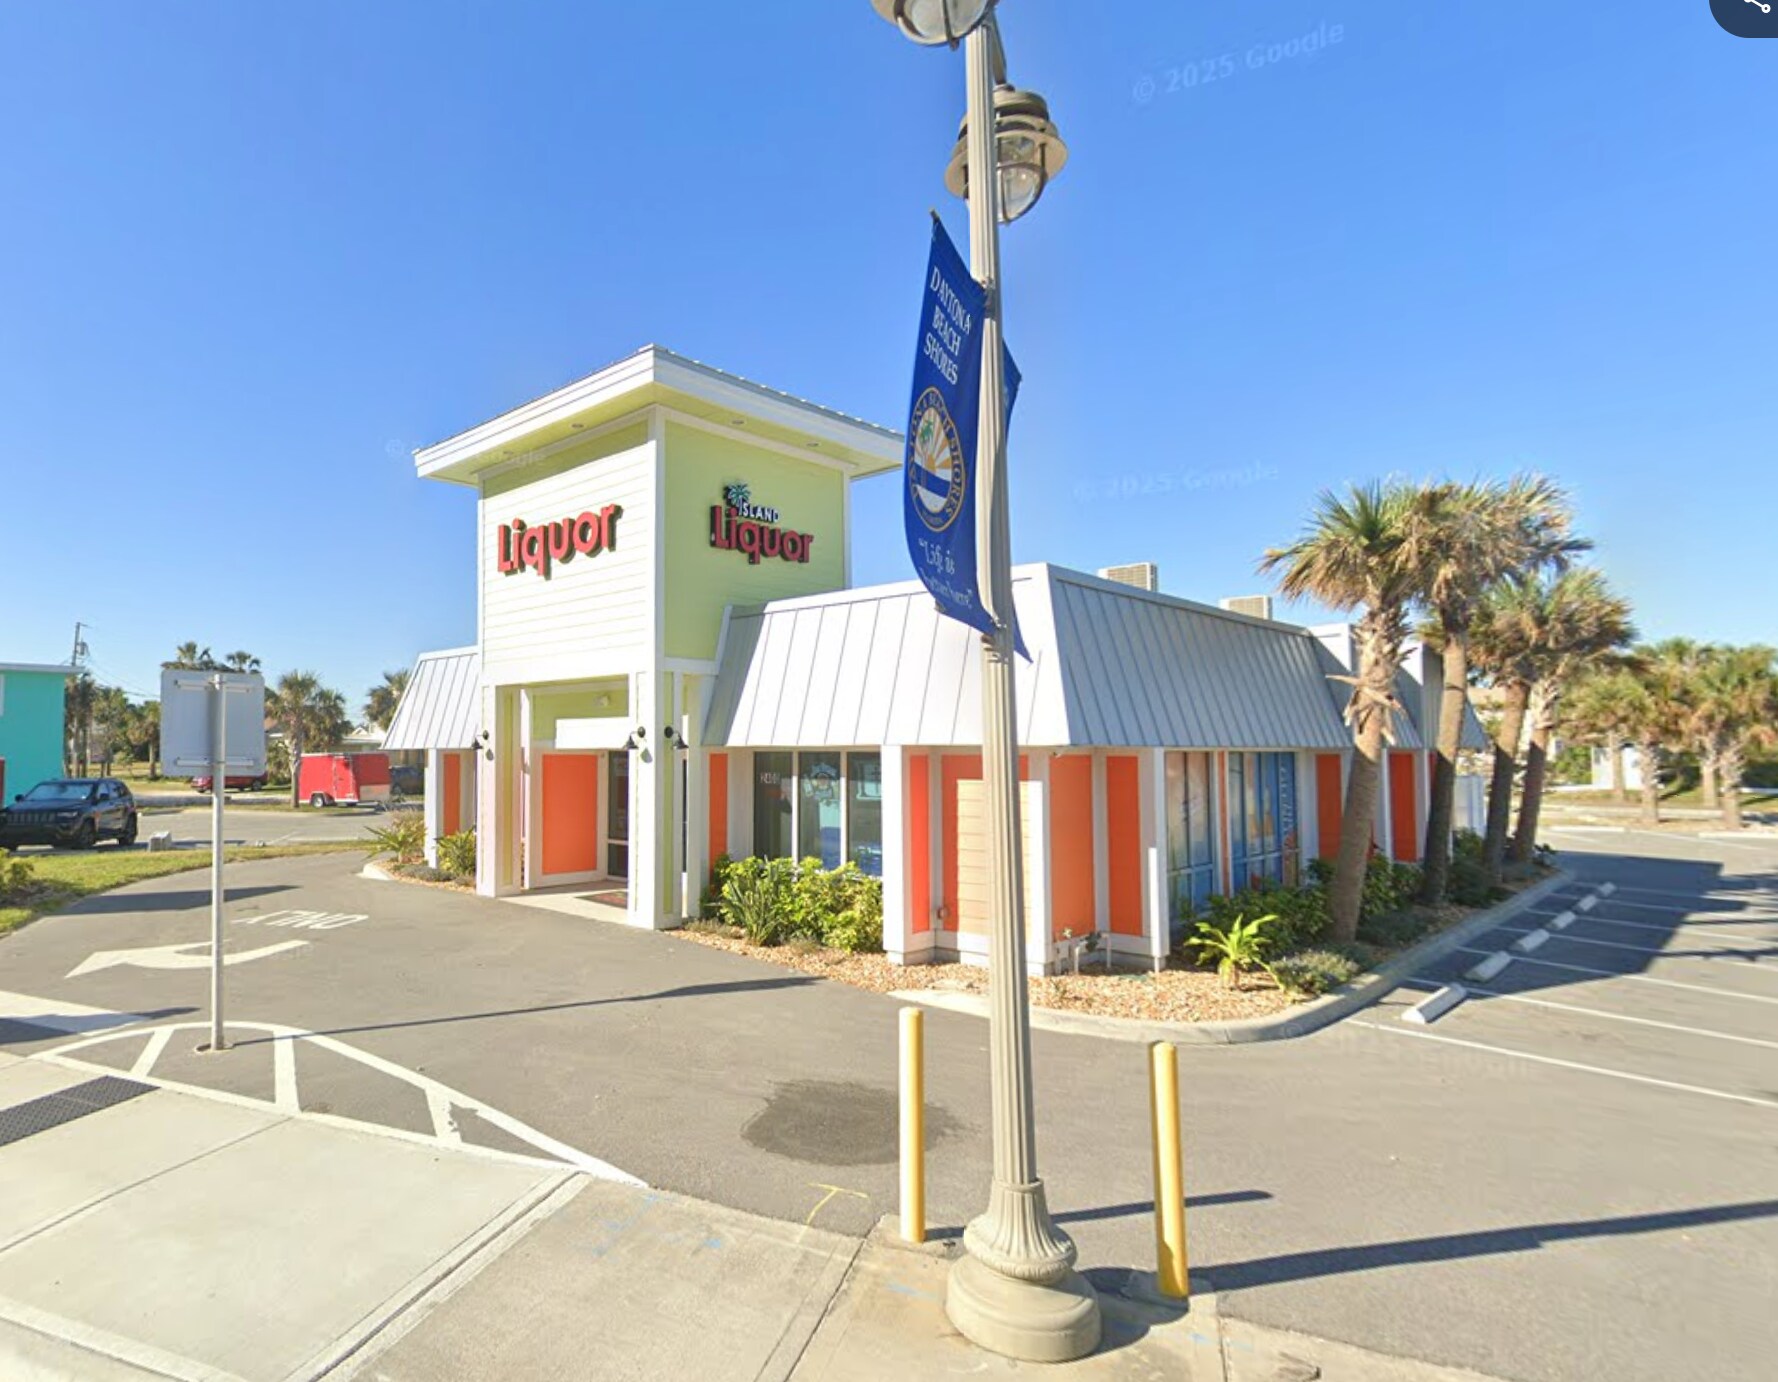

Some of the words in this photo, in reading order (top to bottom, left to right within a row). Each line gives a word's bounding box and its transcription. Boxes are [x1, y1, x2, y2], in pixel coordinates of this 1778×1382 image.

[930, 266, 970, 334] DAYTONA
[932, 303, 961, 356] BEACH
[923, 332, 958, 386] SHORES
[711, 505, 814, 565] Liquor
[737, 502, 780, 523] ISLAND
[497, 503, 622, 580] Liquor
